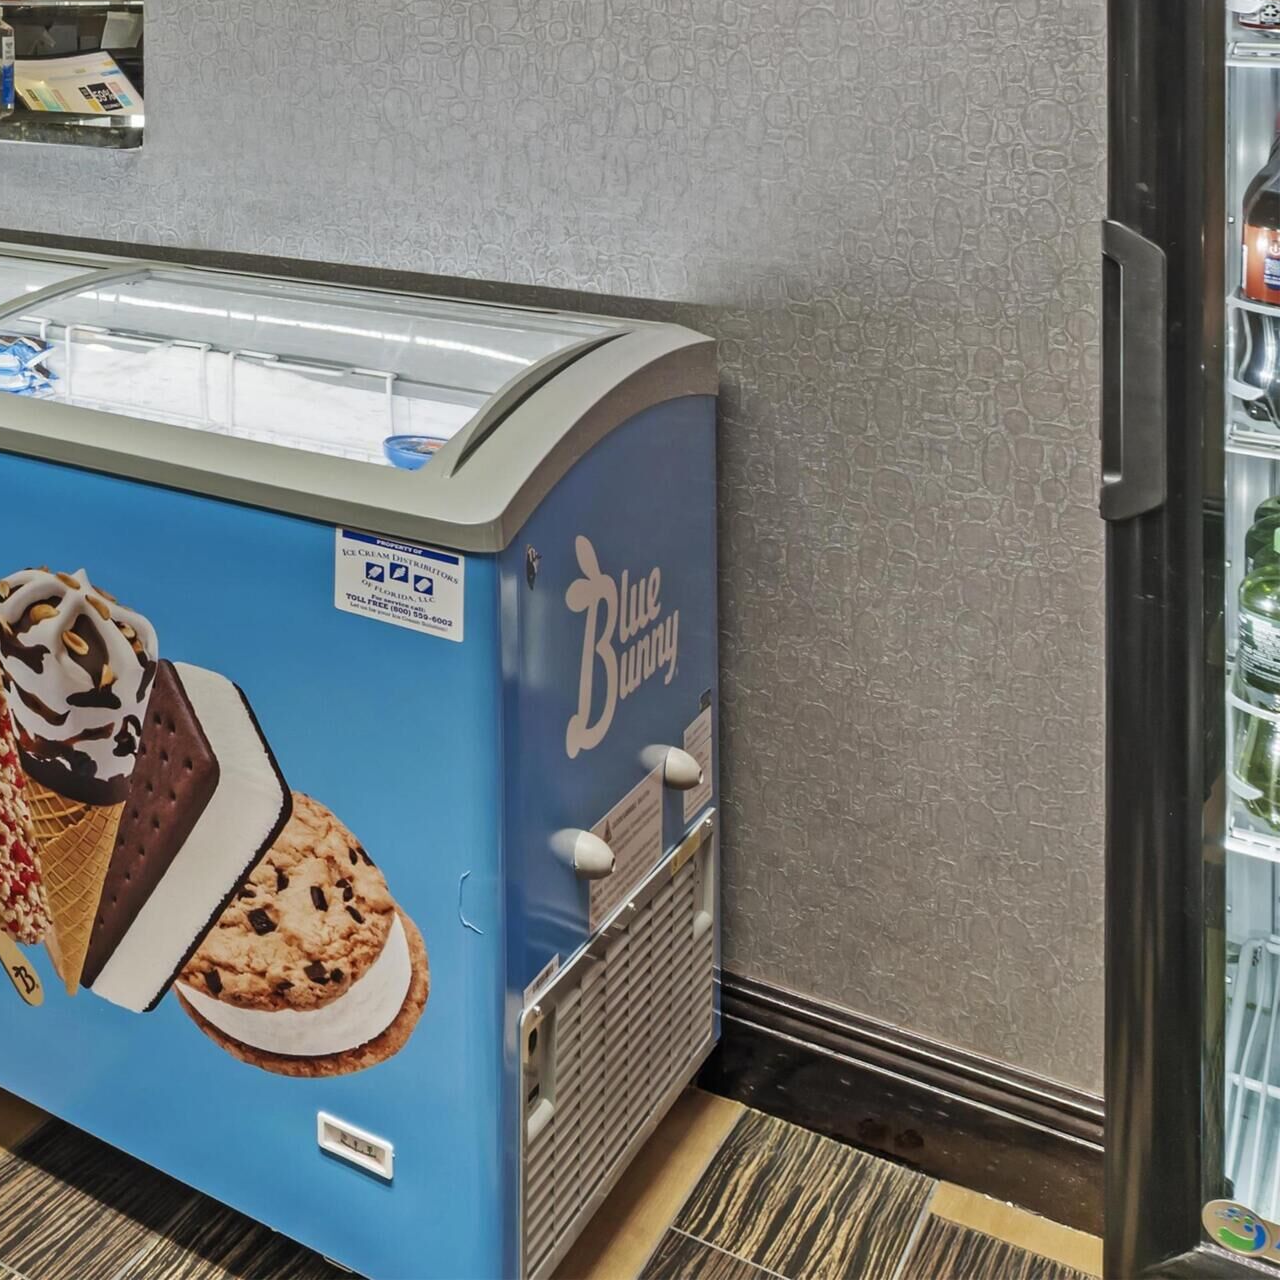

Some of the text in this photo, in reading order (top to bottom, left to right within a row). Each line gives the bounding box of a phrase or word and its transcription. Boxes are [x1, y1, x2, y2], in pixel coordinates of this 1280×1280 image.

[376, 539, 413, 553] PROPERTY
[358, 548, 390, 561] CREAM
[392, 552, 459, 585] DISTRIBUTORS
[361, 579, 372, 589] OF
[374, 585, 417, 604] FLORIDA,
[371, 593, 383, 601] For
[383, 596, 410, 608] service
[345, 592, 366, 604] TOLL
[367, 599, 389, 610] FREE
[390, 604, 413, 618] (800)
